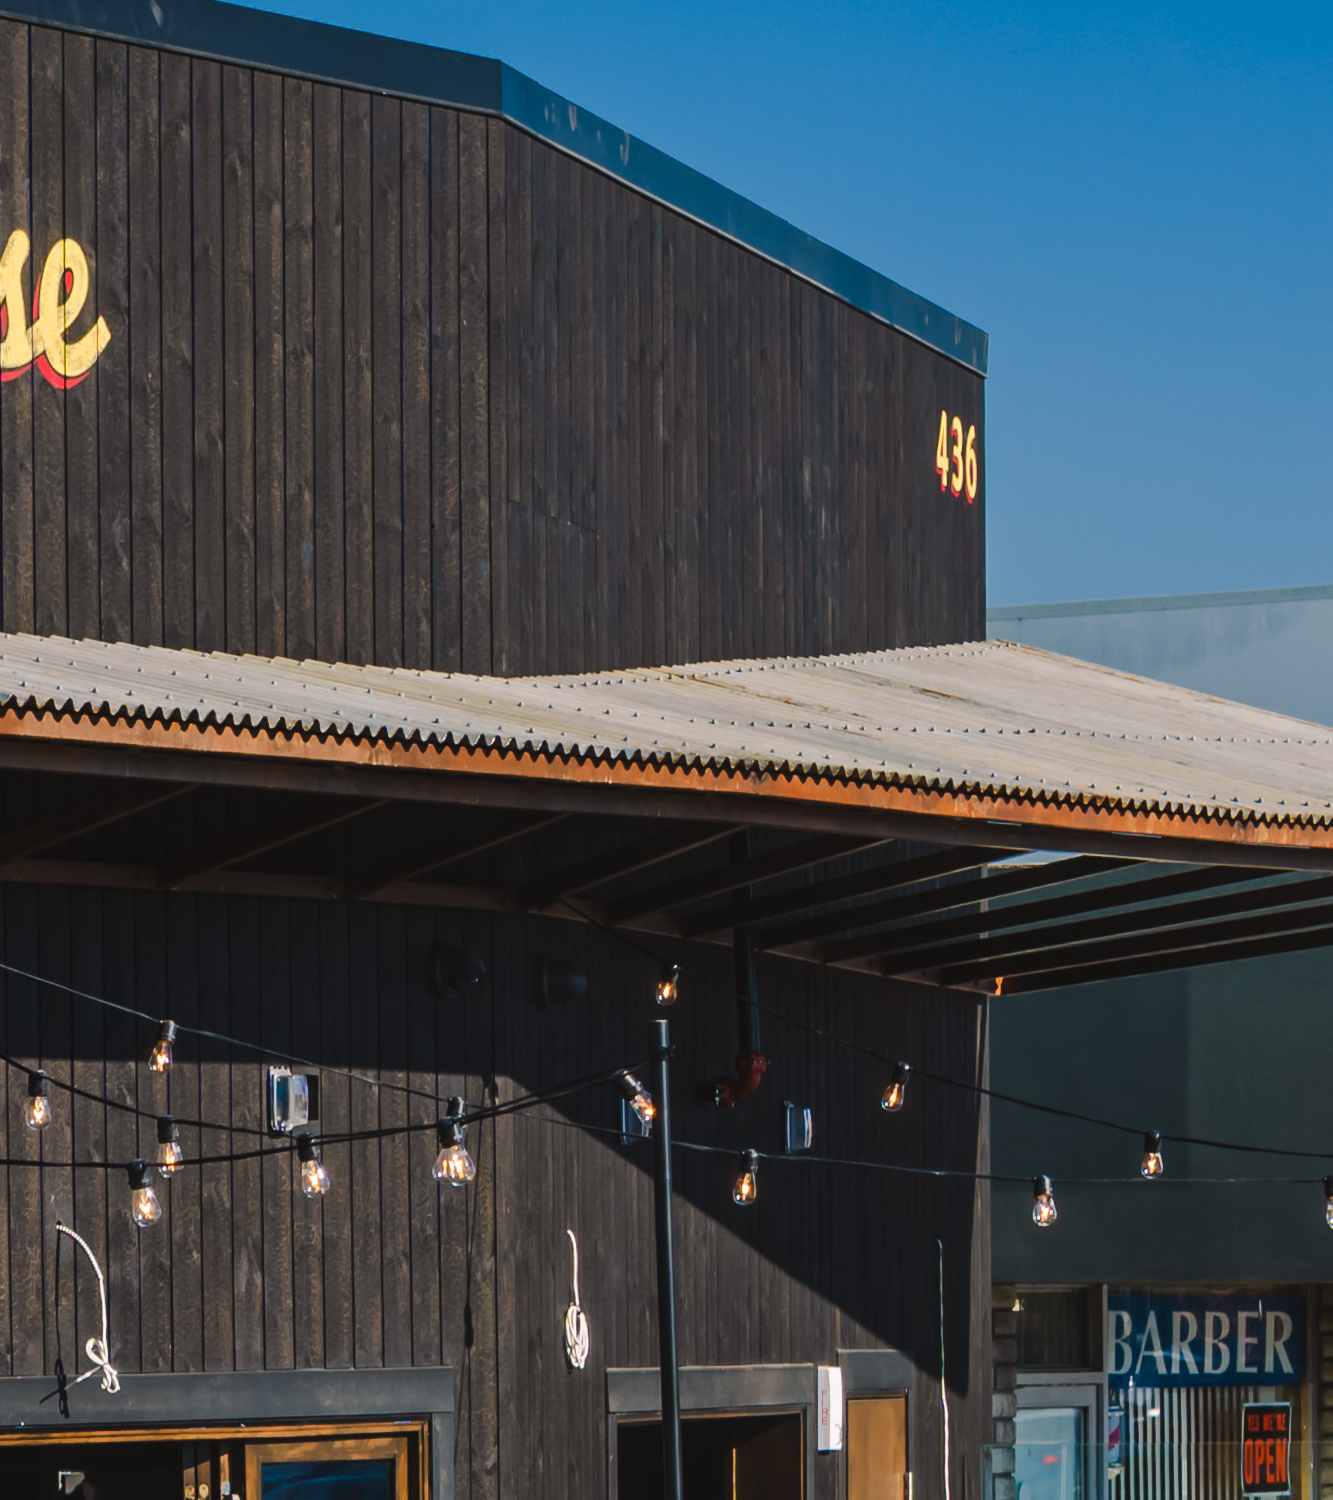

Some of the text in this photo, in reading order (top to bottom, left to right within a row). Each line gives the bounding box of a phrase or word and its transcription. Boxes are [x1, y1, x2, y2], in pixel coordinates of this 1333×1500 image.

[935, 410, 978, 505] 436
[1108, 1310, 1294, 1375] BARBER
[821, 1389, 829, 1426] FIRE
[1244, 1438, 1287, 1484] OPEN
